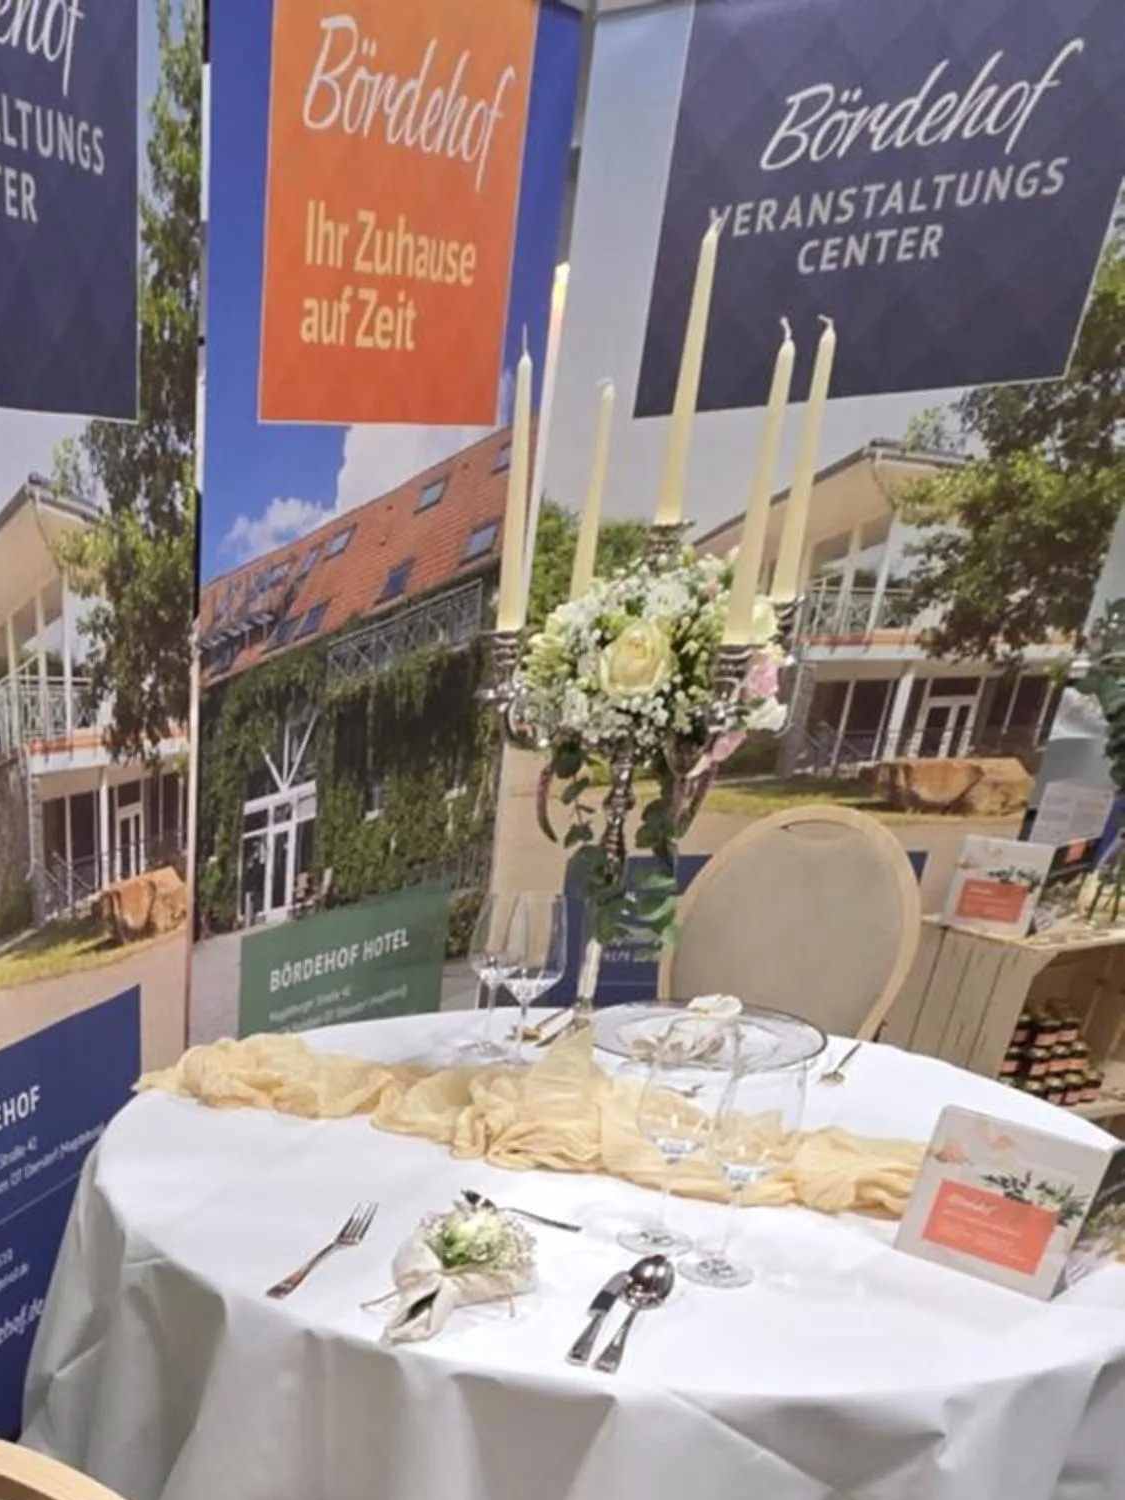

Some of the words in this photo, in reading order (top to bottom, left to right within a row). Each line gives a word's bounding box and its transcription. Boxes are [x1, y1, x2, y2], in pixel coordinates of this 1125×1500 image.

[301, 13, 516, 194] Bördehof
[760, 37, 1084, 171] Bördehof
[709, 156, 1069, 237] VERANSTALTUNGS
[305, 200, 349, 270] Ihr
[354, 210, 477, 288] Zuhause
[797, 224, 944, 275] CENTER
[300, 293, 351, 345] auf
[355, 291, 416, 353] Zeit
[362, 927, 410, 962] HOTEL
